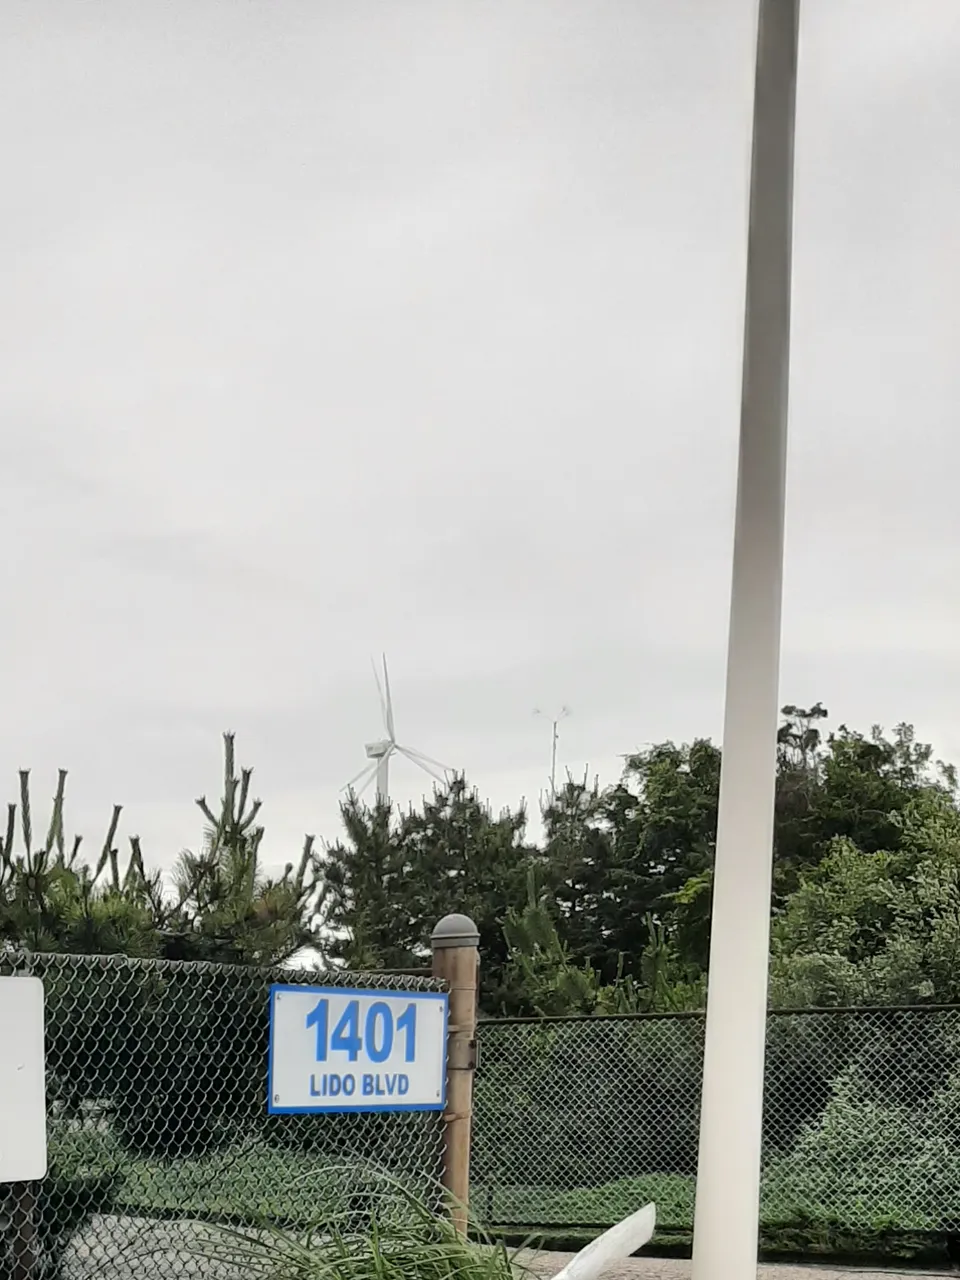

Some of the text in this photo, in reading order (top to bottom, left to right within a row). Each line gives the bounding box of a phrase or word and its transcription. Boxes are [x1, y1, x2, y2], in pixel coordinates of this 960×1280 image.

[306, 998, 417, 1064] 1401
[309, 1073, 410, 1097] LIDO BLVD
